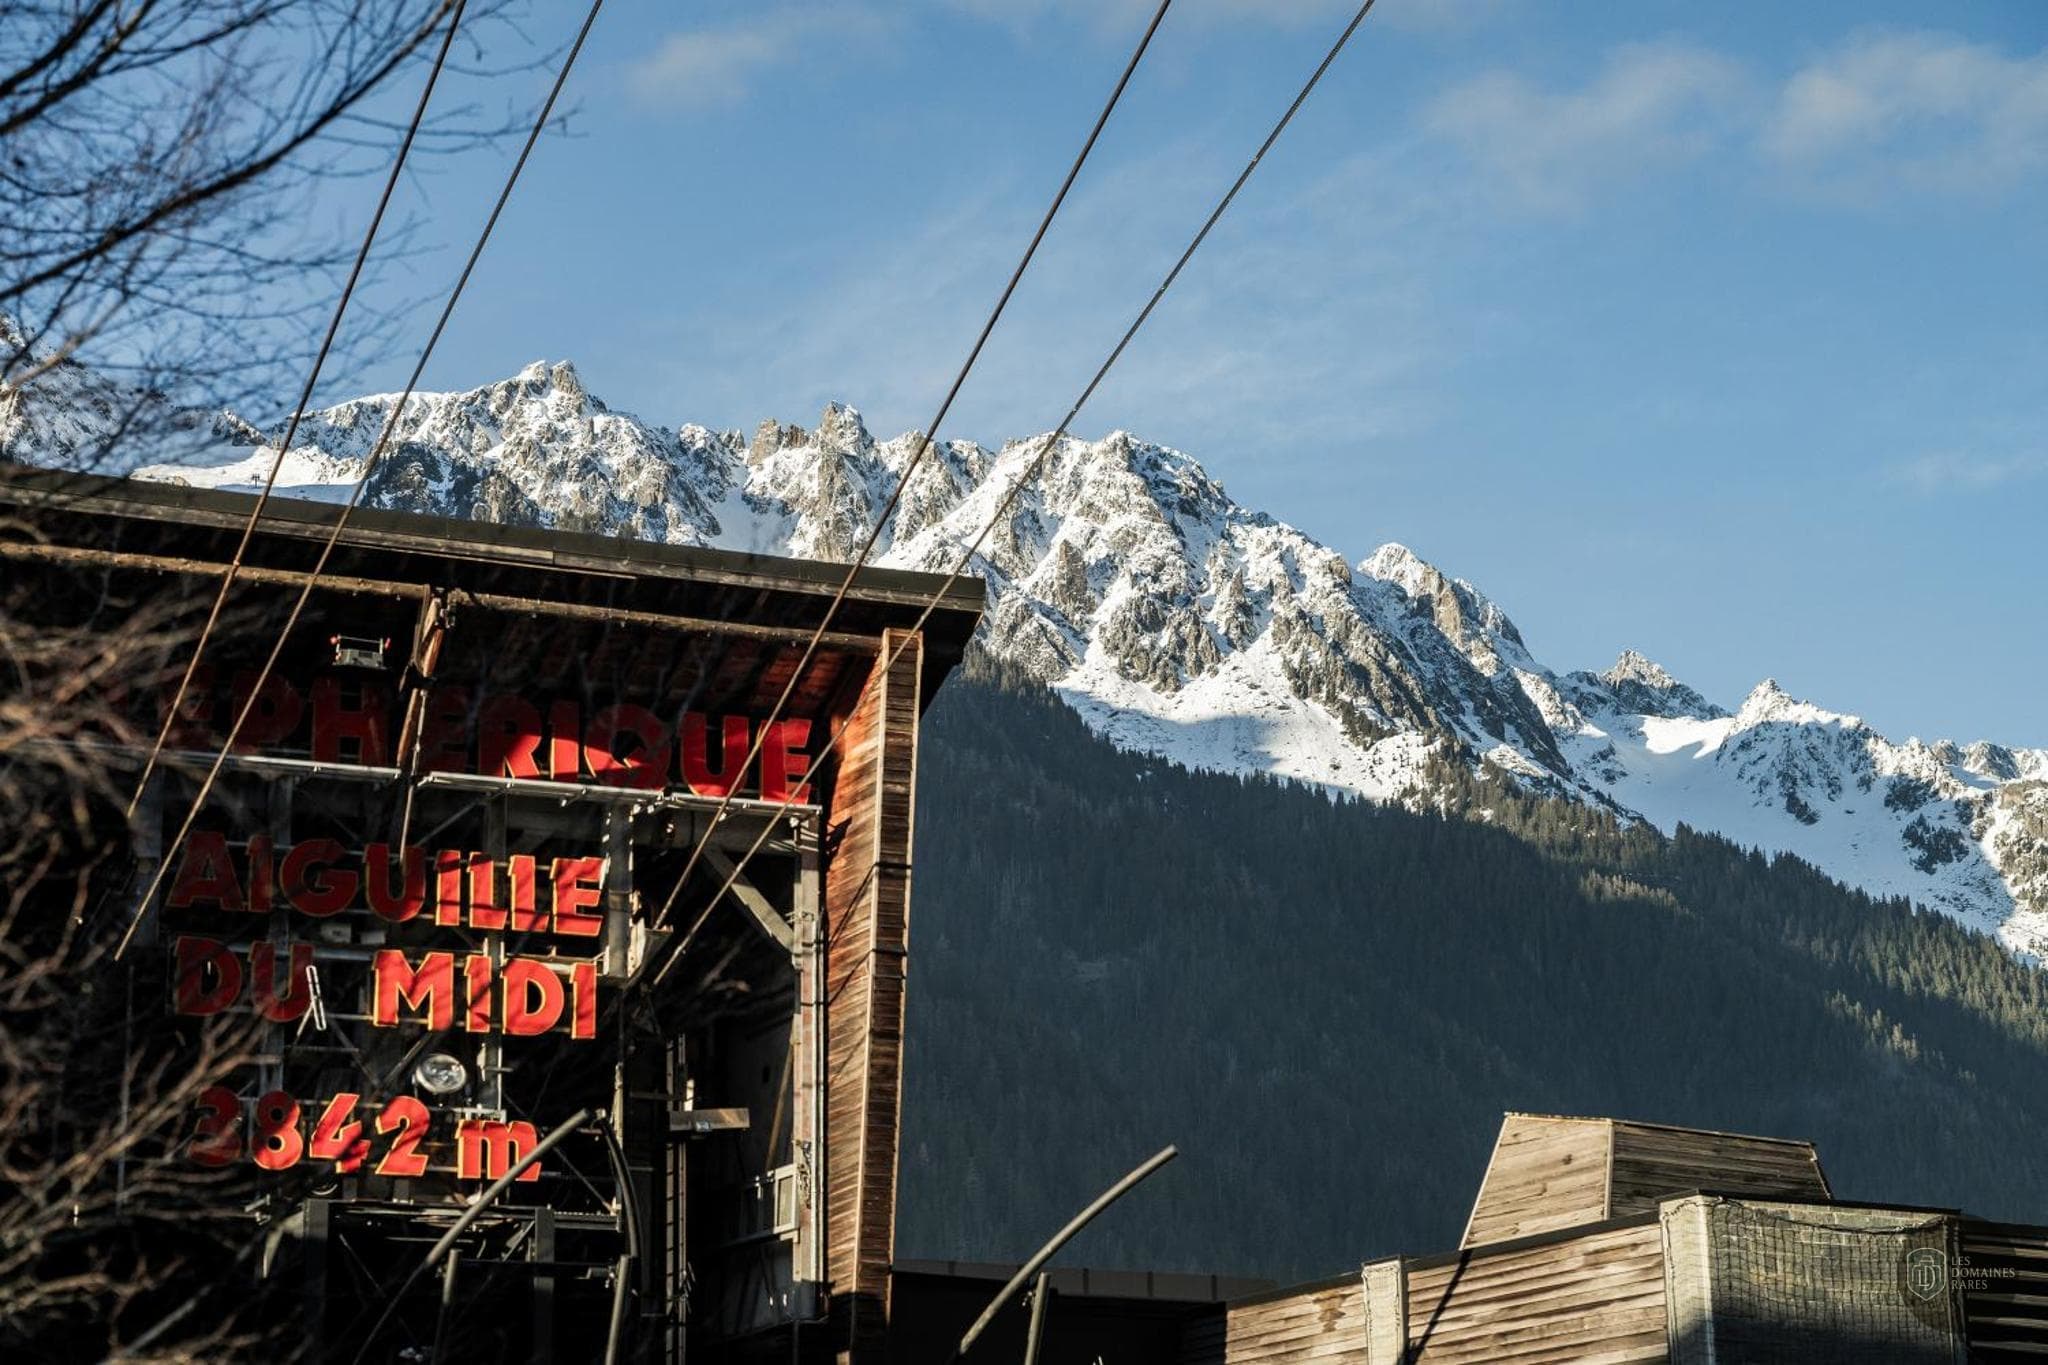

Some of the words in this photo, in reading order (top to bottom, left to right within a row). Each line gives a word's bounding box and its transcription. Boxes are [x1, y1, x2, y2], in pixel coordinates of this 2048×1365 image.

[168, 831, 607, 937] AIGUILLE
[174, 935, 313, 1023] DU
[373, 949, 598, 1040] MIDI
[186, 1086, 432, 1178] 3842
